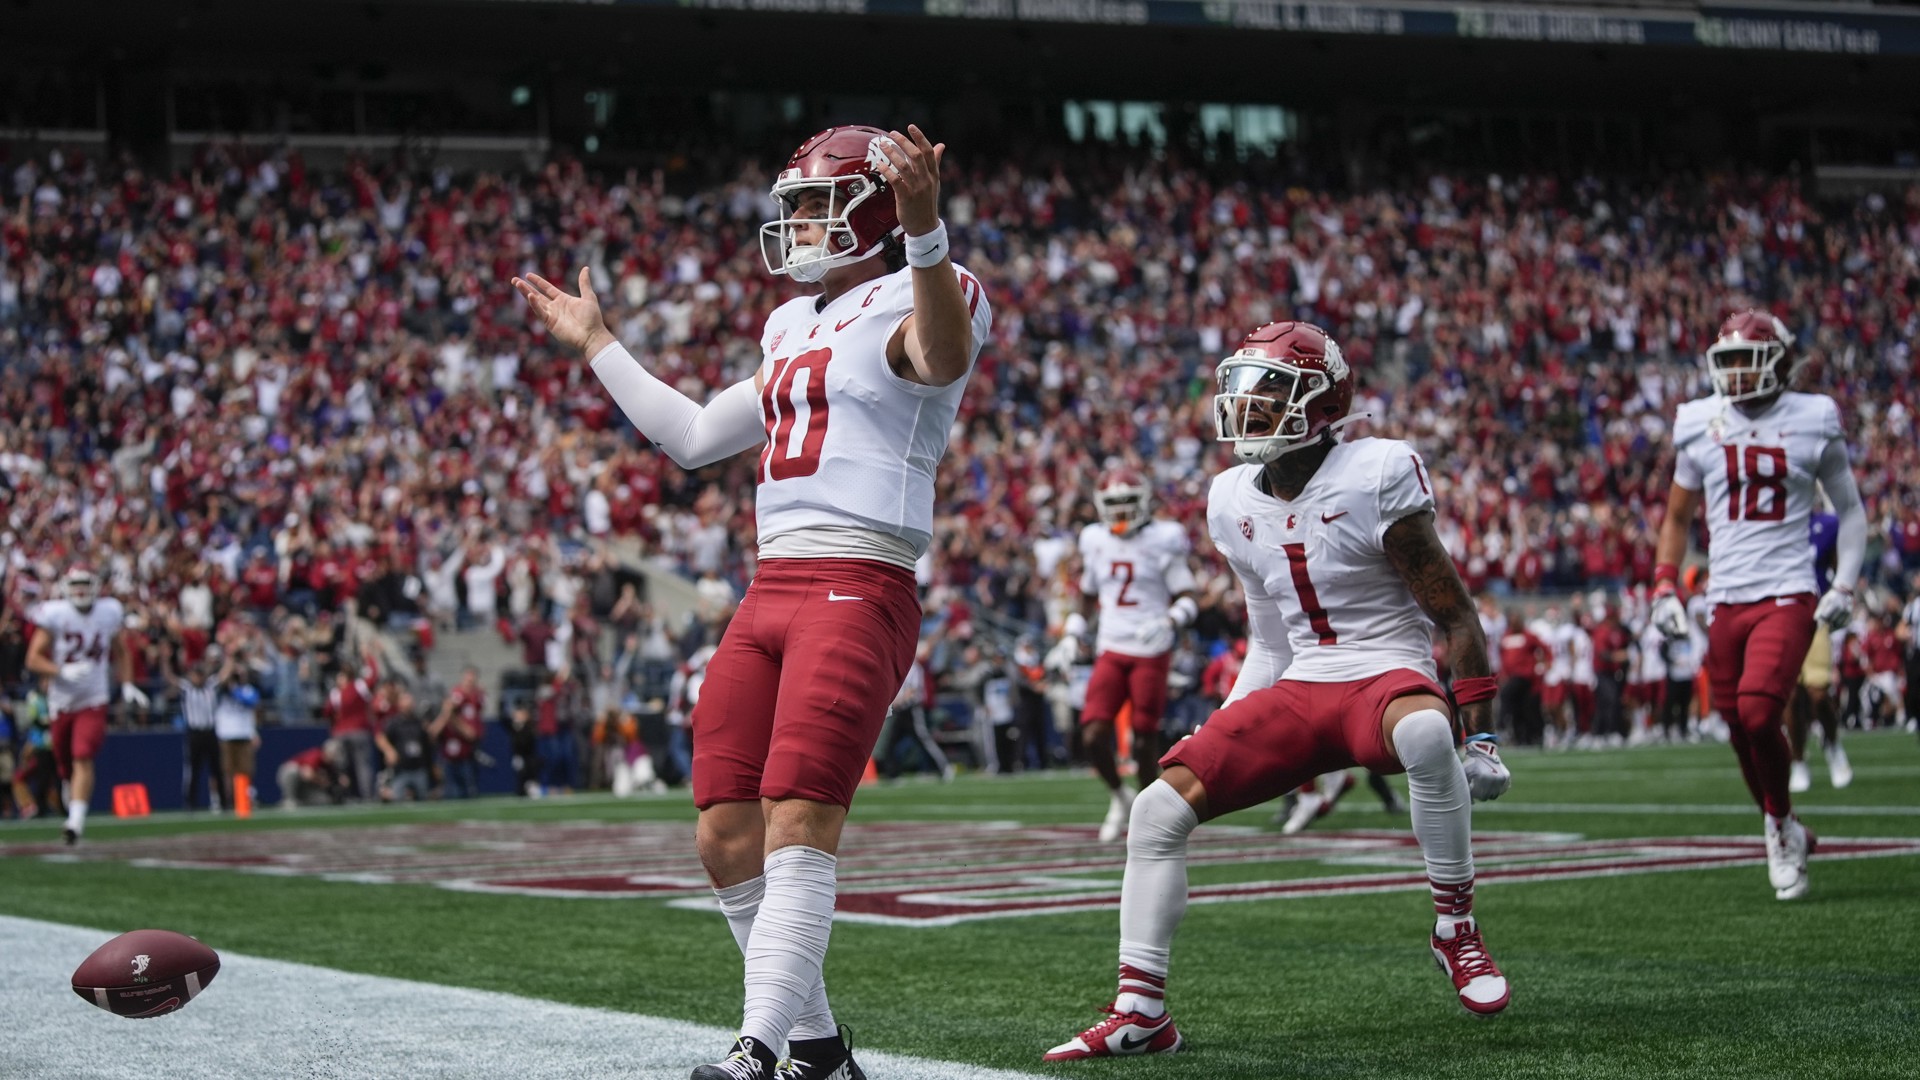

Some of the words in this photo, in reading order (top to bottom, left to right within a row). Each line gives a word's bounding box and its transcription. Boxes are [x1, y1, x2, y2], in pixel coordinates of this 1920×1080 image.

[861, 285, 882, 308] C
[757, 347, 832, 485] 10
[1411, 454, 1429, 495] 1
[1723, 445, 1787, 521] 18
[1111, 562, 1138, 606] 2
[1282, 543, 1337, 645] 1
[64, 632, 104, 663] 24
